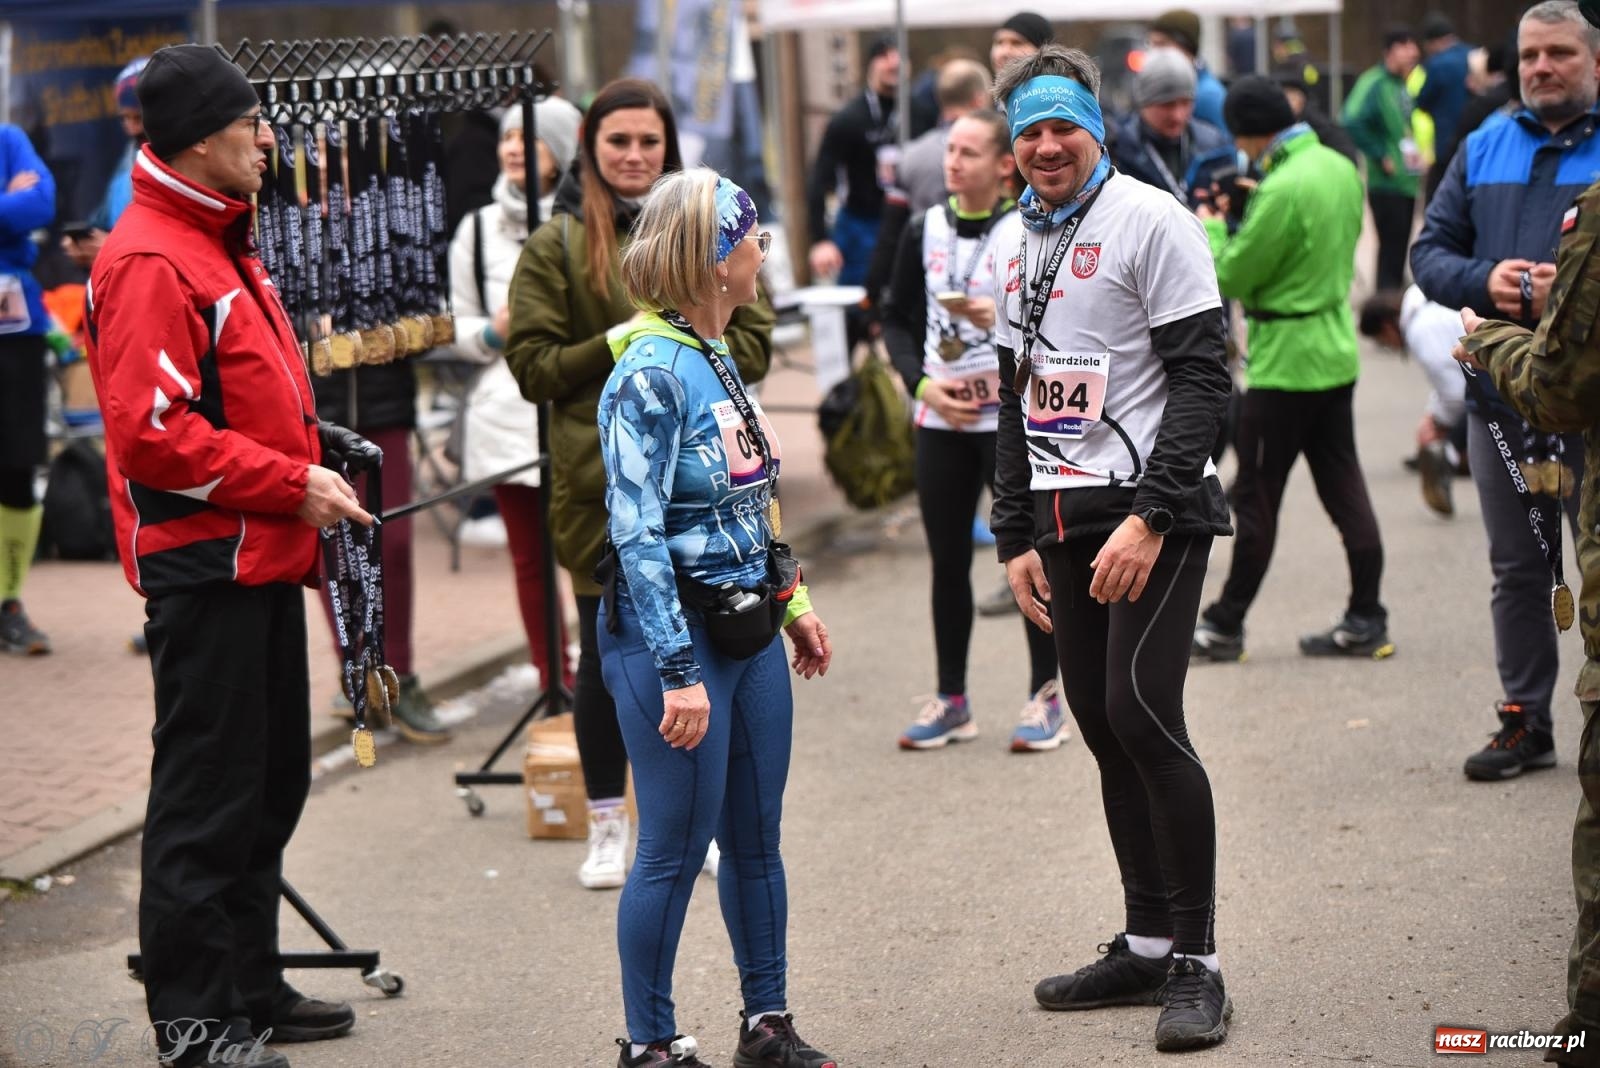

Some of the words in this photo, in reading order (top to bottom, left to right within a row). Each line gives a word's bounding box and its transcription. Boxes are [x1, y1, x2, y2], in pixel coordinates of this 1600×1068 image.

[1033, 304, 1044, 317] 13
[1046, 217, 1080, 277] TWARDZIELA
[709, 352, 751, 417] TWARDZIELA
[1045, 355, 1101, 367] Twardziela
[1037, 379, 1089, 413] 084
[1487, 421, 1529, 495] 23.02.2025
[328, 580, 349, 647] 23.02.2025
